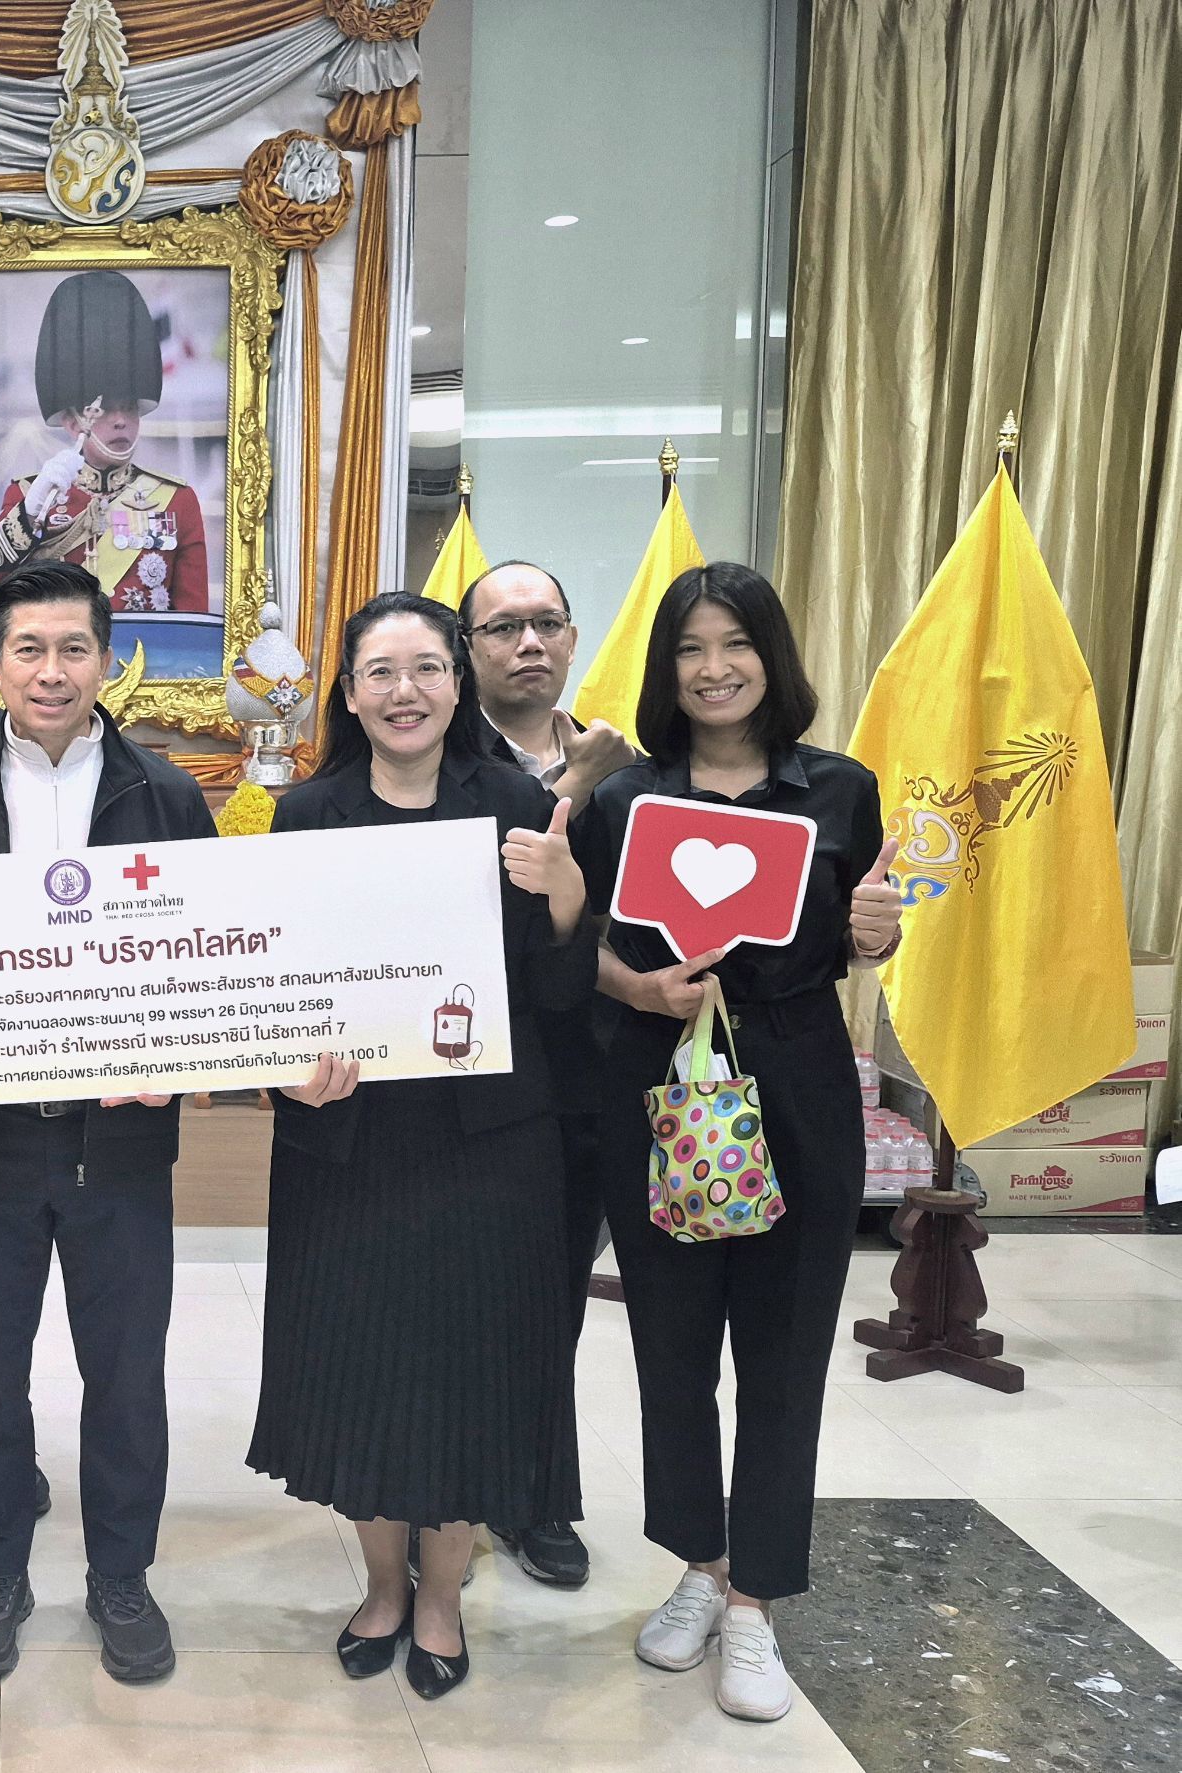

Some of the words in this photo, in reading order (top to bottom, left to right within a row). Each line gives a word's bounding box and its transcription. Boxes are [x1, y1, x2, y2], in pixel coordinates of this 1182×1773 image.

[103, 893, 184, 912] สภากาชาดไทย
[47, 909, 93, 925] MIND
[140, 975, 275, 997] สมเด็จพระสังฆราช
[279, 964, 443, 987] สกลมหาสังฆปริณายก
[149, 1009, 166, 1022] 99
[169, 1007, 216, 1020] พรรษา
[218, 1004, 236, 1017] 26
[239, 1002, 296, 1019] มิถุนายน
[298, 998, 334, 1011] 2569
[1134, 1018, 1166, 1029] วังแตก
[61, 1032, 147, 1054] รำไพพรรณี
[151, 1026, 251, 1049] พระบรมราชินี
[254, 1015, 333, 1041] ในรัชกาลที่
[336, 1022, 347, 1036] 7
[348, 1047, 375, 1061] 100
[377, 1044, 389, 1059] ปี
[1099, 1085, 1142, 1096] ระวังแตก
[1099, 1152, 1142, 1163] ระวังแตก
[1010, 1173, 1073, 1191] Farmhouse
